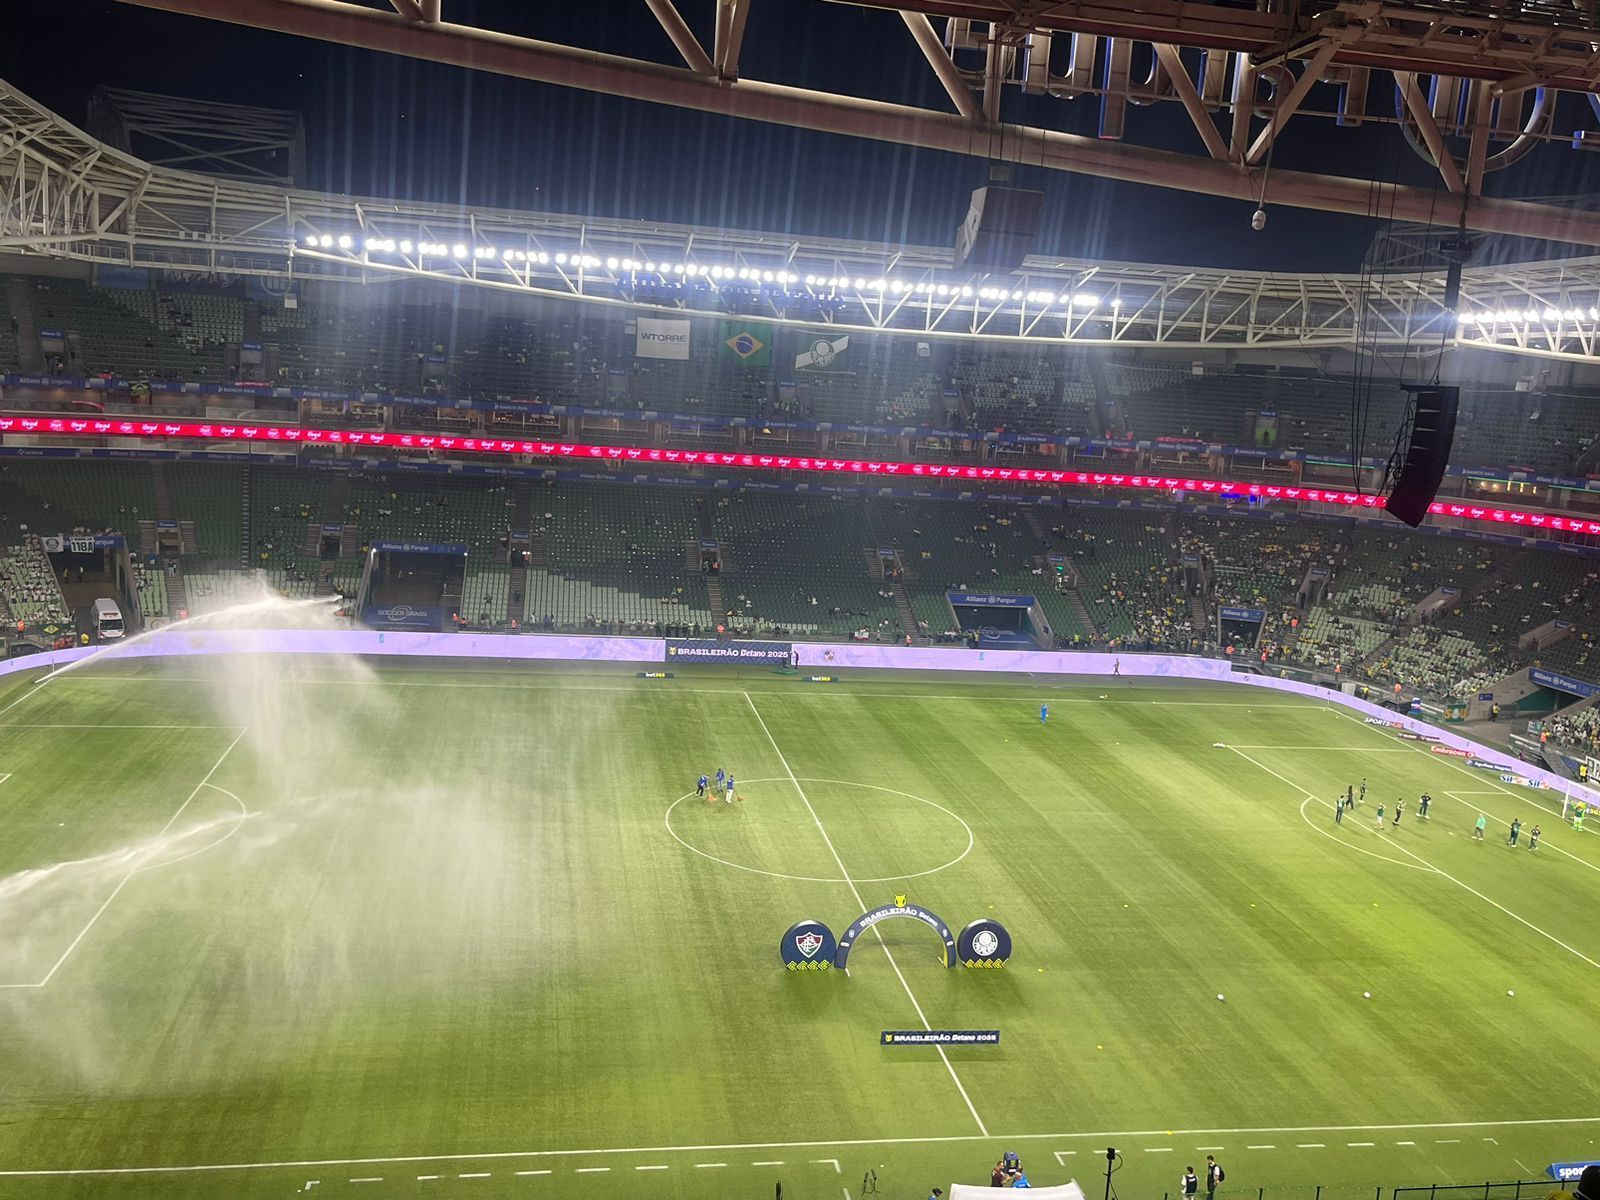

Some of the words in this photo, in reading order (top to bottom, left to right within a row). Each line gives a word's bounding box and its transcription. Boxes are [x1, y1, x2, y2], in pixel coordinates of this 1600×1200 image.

[640, 333, 687, 343] WTORRE
[71, 542, 94, 552] 118A
[677, 648, 739, 657] BRASILEIRÃO
[740, 649, 766, 658] Betano
[1533, 672, 1552, 682] Allianz
[1559, 680, 1577, 690] Parque
[1430, 745, 1467, 758] Embracon
[859, 907, 917, 927] BRASILEIRÃO
[918, 911, 938, 928] Betano
[894, 1032, 951, 1041] BRASILEIRÃO
[1558, 1165, 1588, 1179] spor
